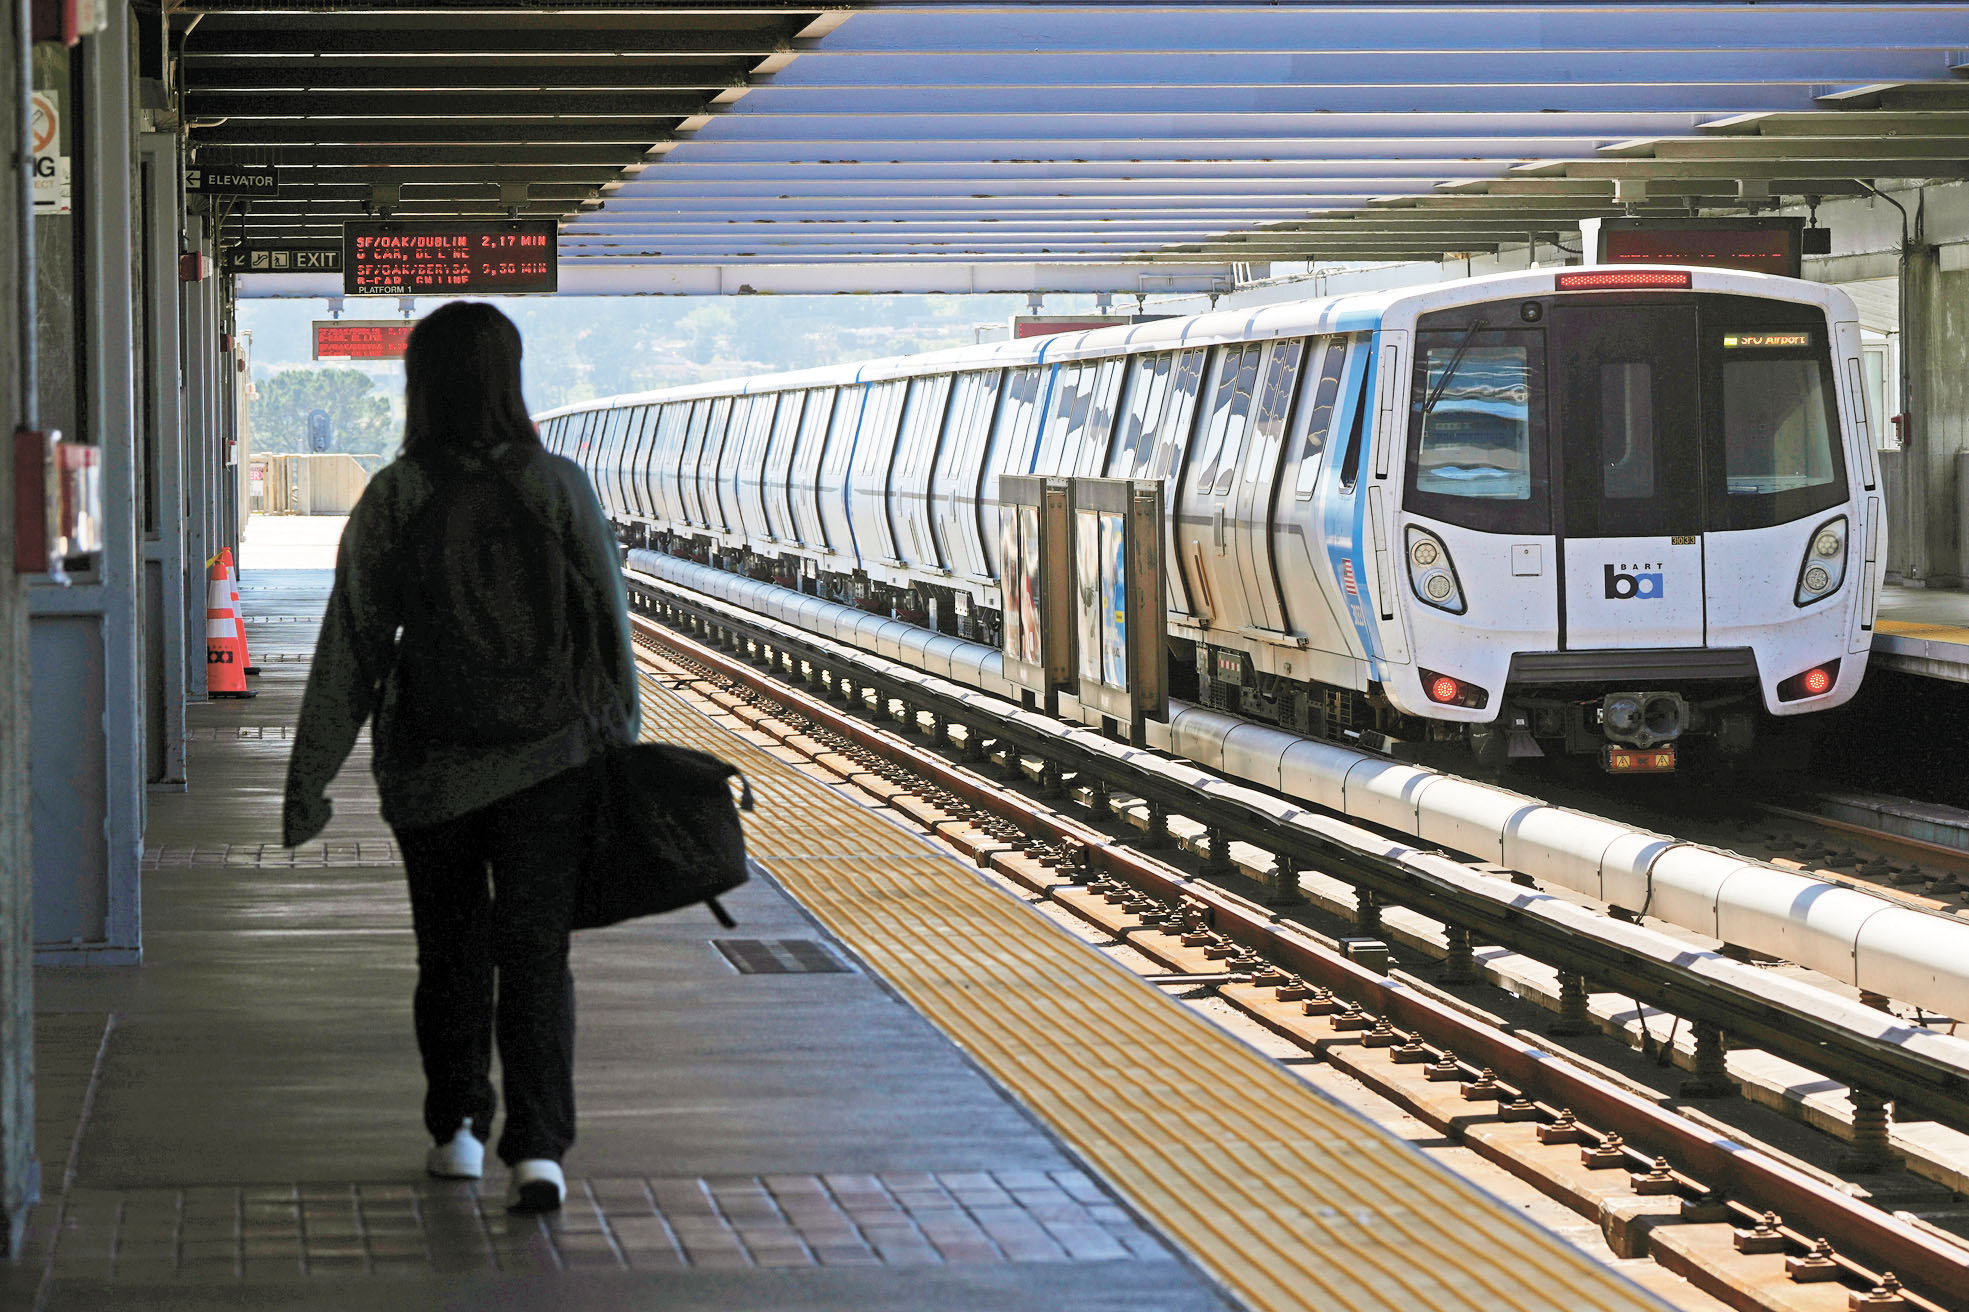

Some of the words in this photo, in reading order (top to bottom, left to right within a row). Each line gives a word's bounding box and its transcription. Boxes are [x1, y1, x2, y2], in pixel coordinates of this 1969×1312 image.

[208, 175, 273, 186] ELEVATOR
[356, 235, 467, 248] SF/OAK/DUBLIN
[520, 235, 546, 247] MIN
[297, 252, 336, 267] EXIT
[358, 286, 405, 294] PLATFORM
[1764, 336, 1806, 345] Airport
[1671, 535, 1696, 546] 3033
[1620, 563, 1663, 571] BART
